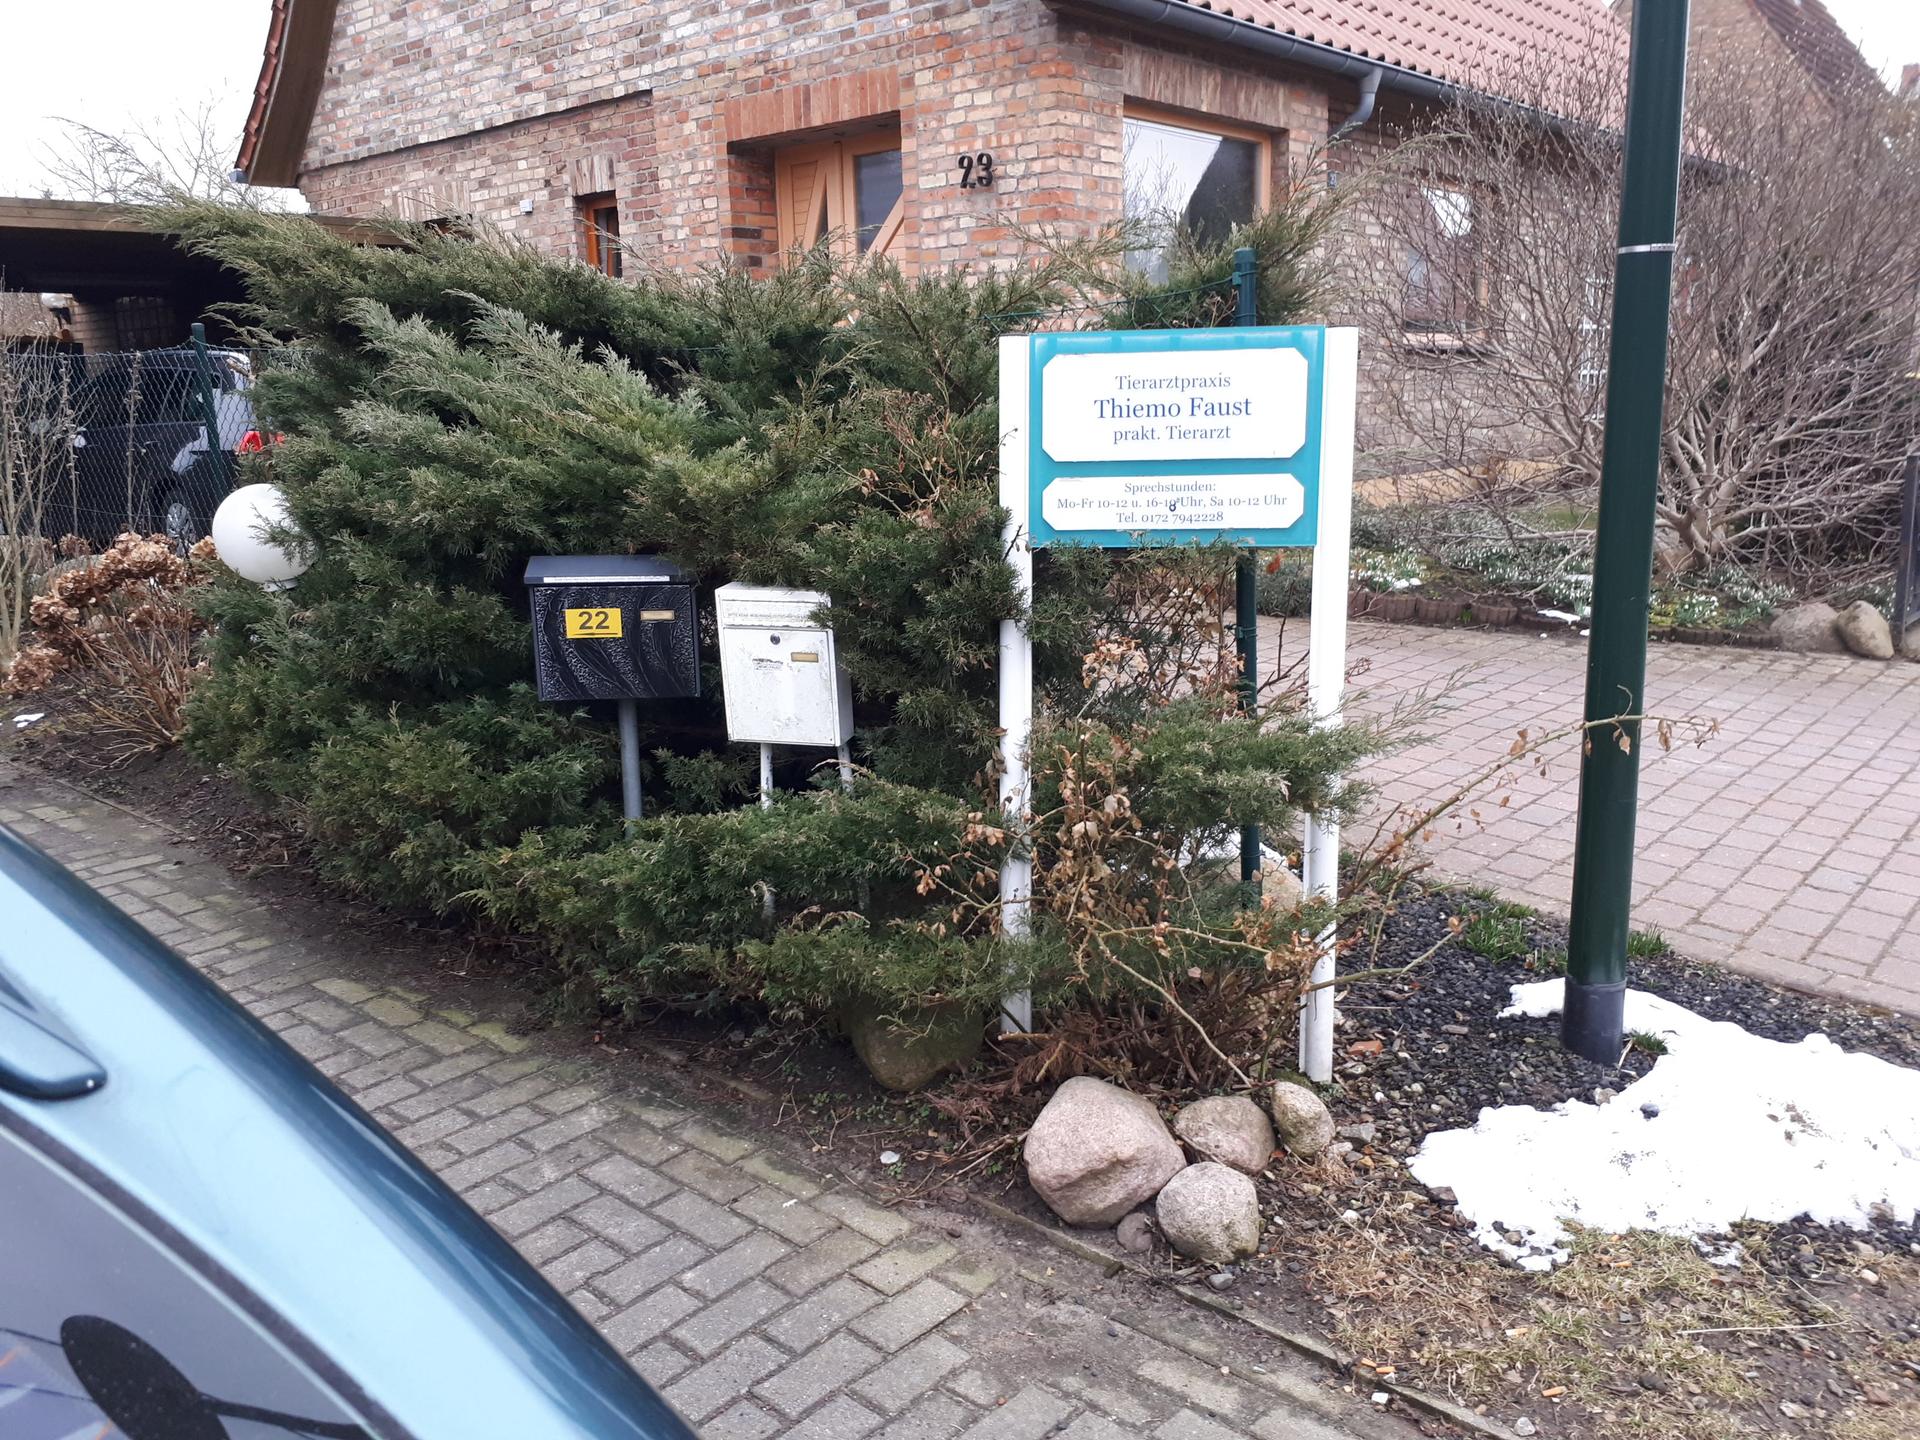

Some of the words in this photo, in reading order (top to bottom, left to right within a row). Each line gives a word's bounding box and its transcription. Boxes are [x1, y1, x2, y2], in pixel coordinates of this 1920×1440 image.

[958, 153, 993, 189] 23
[1115, 373, 1231, 392] Tierarztpraxis
[1094, 398, 1181, 418] Thiemo
[1189, 397, 1252, 417] Faust
[1113, 425, 1161, 444] prakt.
[1166, 424, 1231, 440] Tierarzt
[1124, 481, 1216, 495] Sprechstunden:
[1057, 498, 1094, 509] Mo-Fr
[1097, 499, 1128, 508] 10-12
[1131, 499, 1142, 508] u.
[1209, 495, 1224, 507] Sa
[1228, 497, 1260, 506] 10-12
[1264, 494, 1287, 506] Uhr
[1116, 512, 1138, 523] Tel.
[1141, 514, 1169, 524] 0172
[1172, 511, 1224, 524] 7942228
[578, 611, 610, 630] 22
